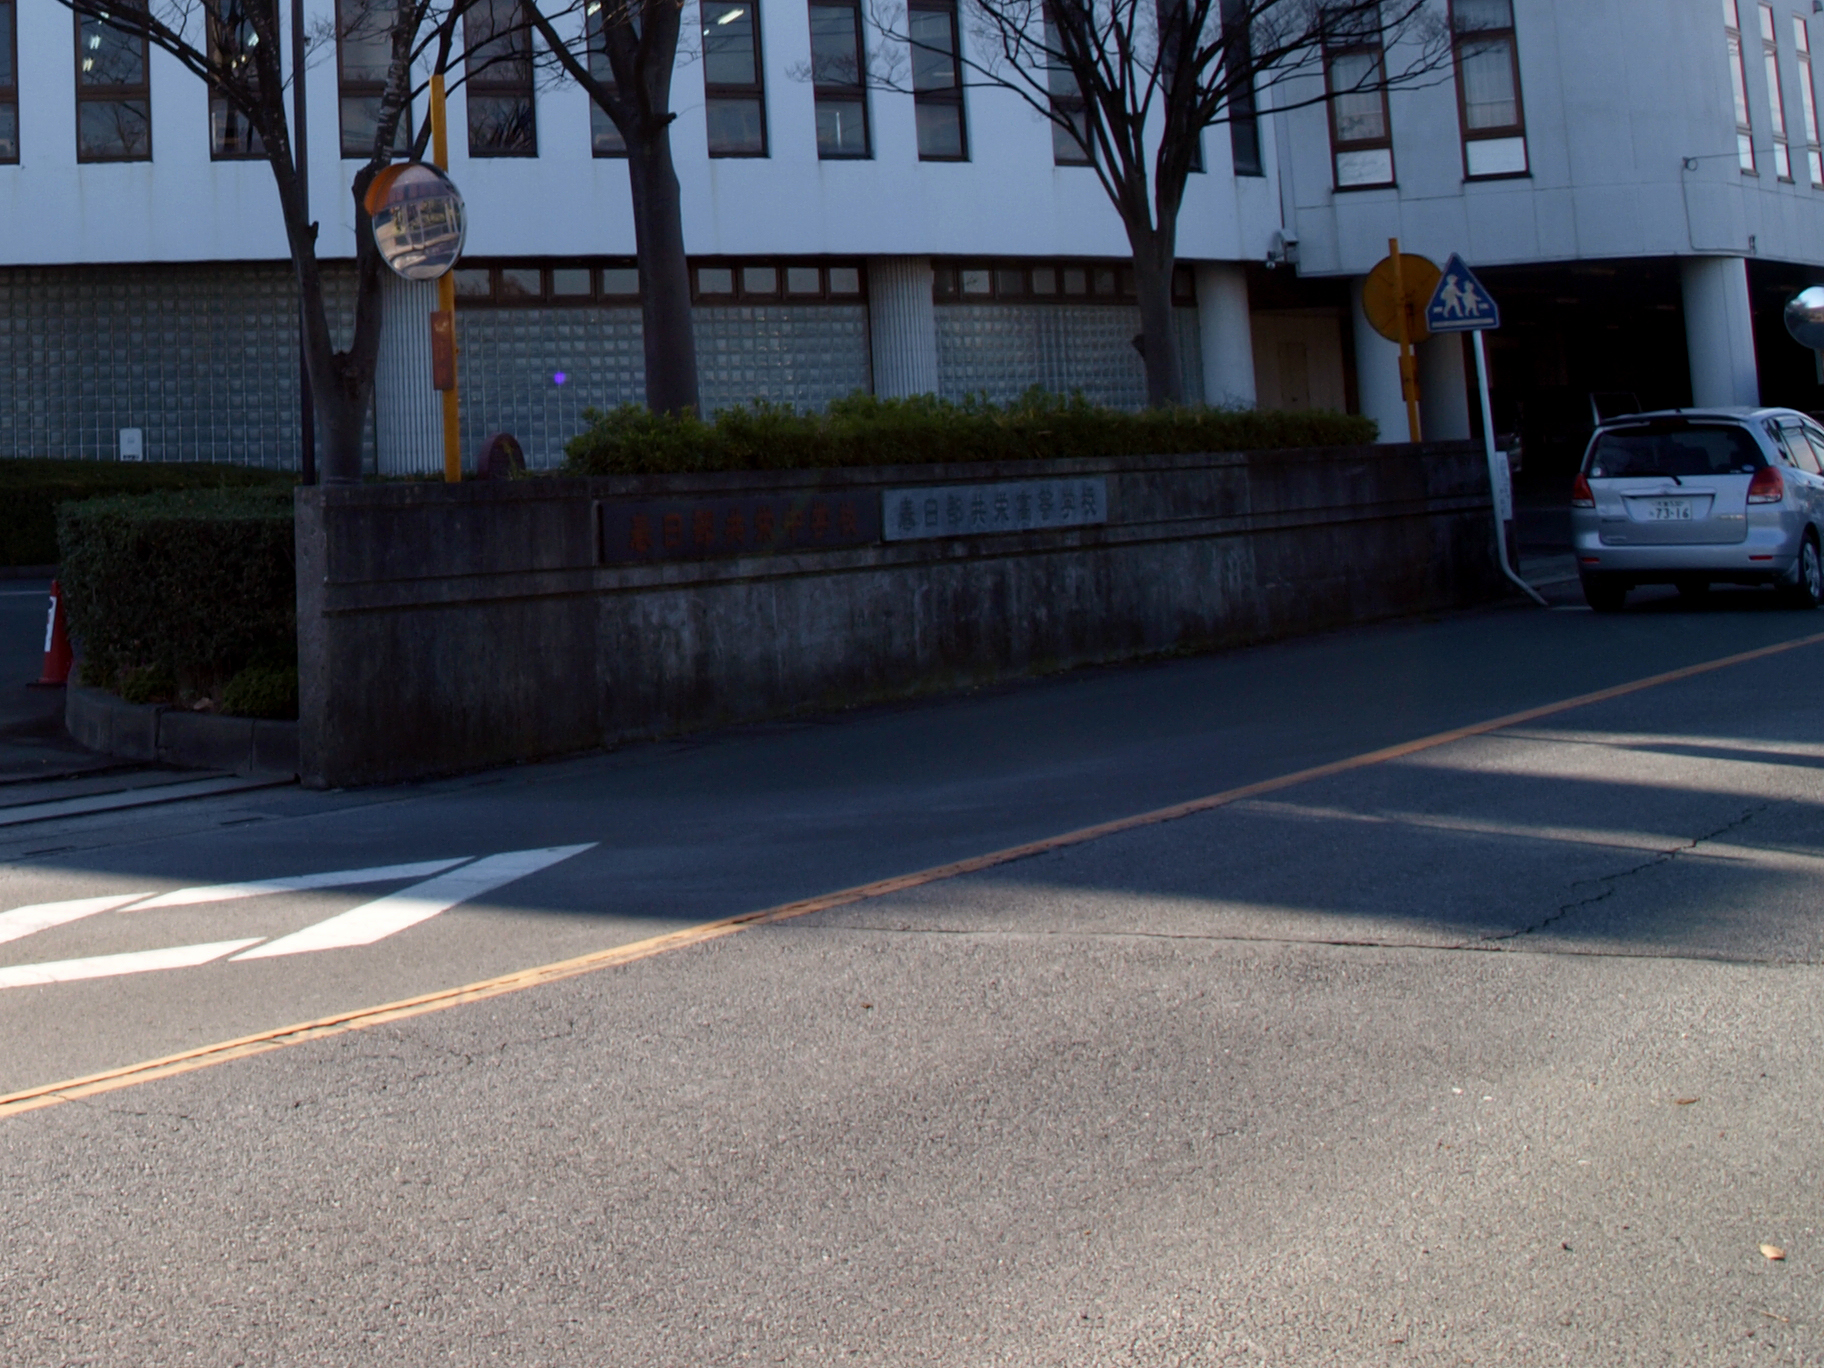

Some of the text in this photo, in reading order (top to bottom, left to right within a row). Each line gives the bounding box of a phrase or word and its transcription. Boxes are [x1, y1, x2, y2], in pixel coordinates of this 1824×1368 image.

[629, 499, 859, 553] 春日部共栄中学校
[897, 481, 1098, 531] 春日部共栄高等学校
